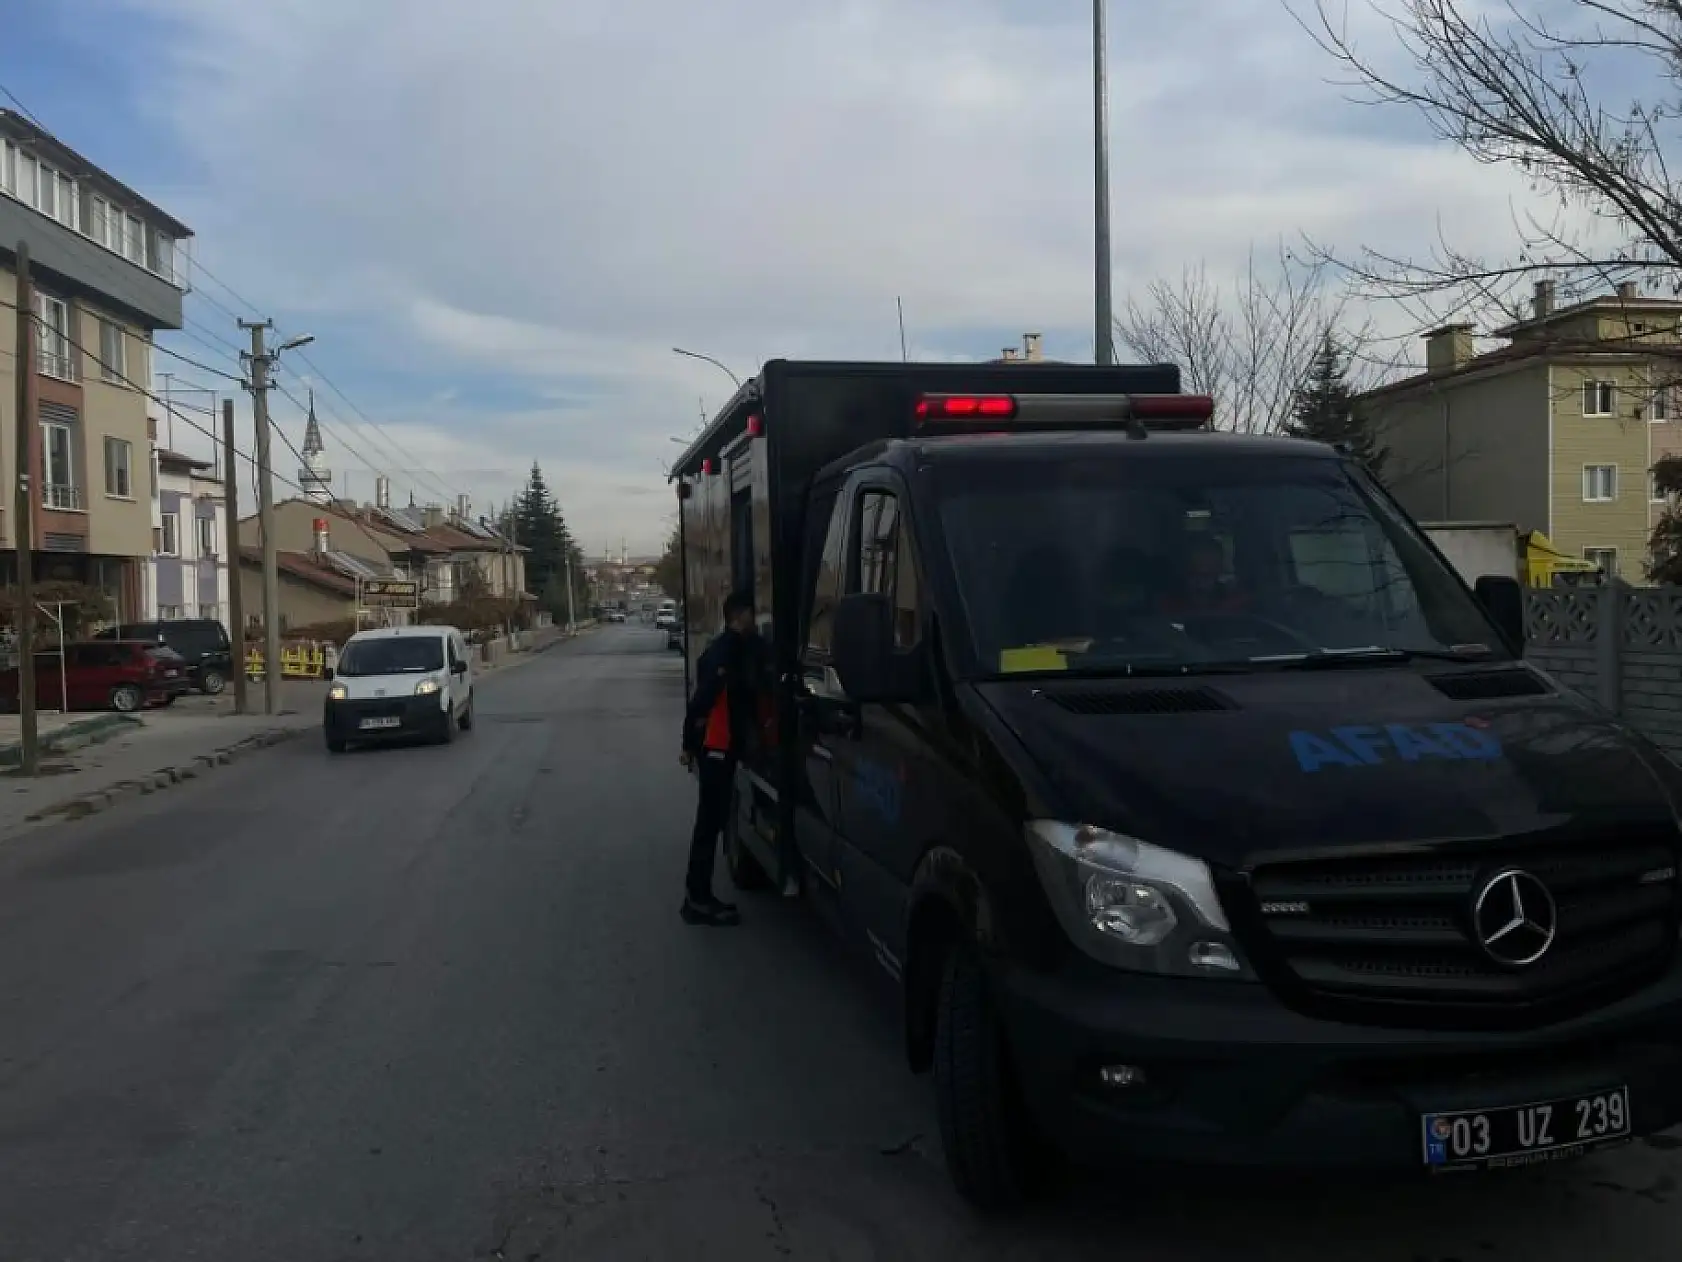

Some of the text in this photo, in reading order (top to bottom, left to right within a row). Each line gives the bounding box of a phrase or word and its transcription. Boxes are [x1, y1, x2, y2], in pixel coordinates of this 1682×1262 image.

[1288, 723, 1502, 773] AFAD
[1452, 1115, 1491, 1156] 03
[1517, 1105, 1555, 1147] UZ
[1575, 1092, 1624, 1138] 239
